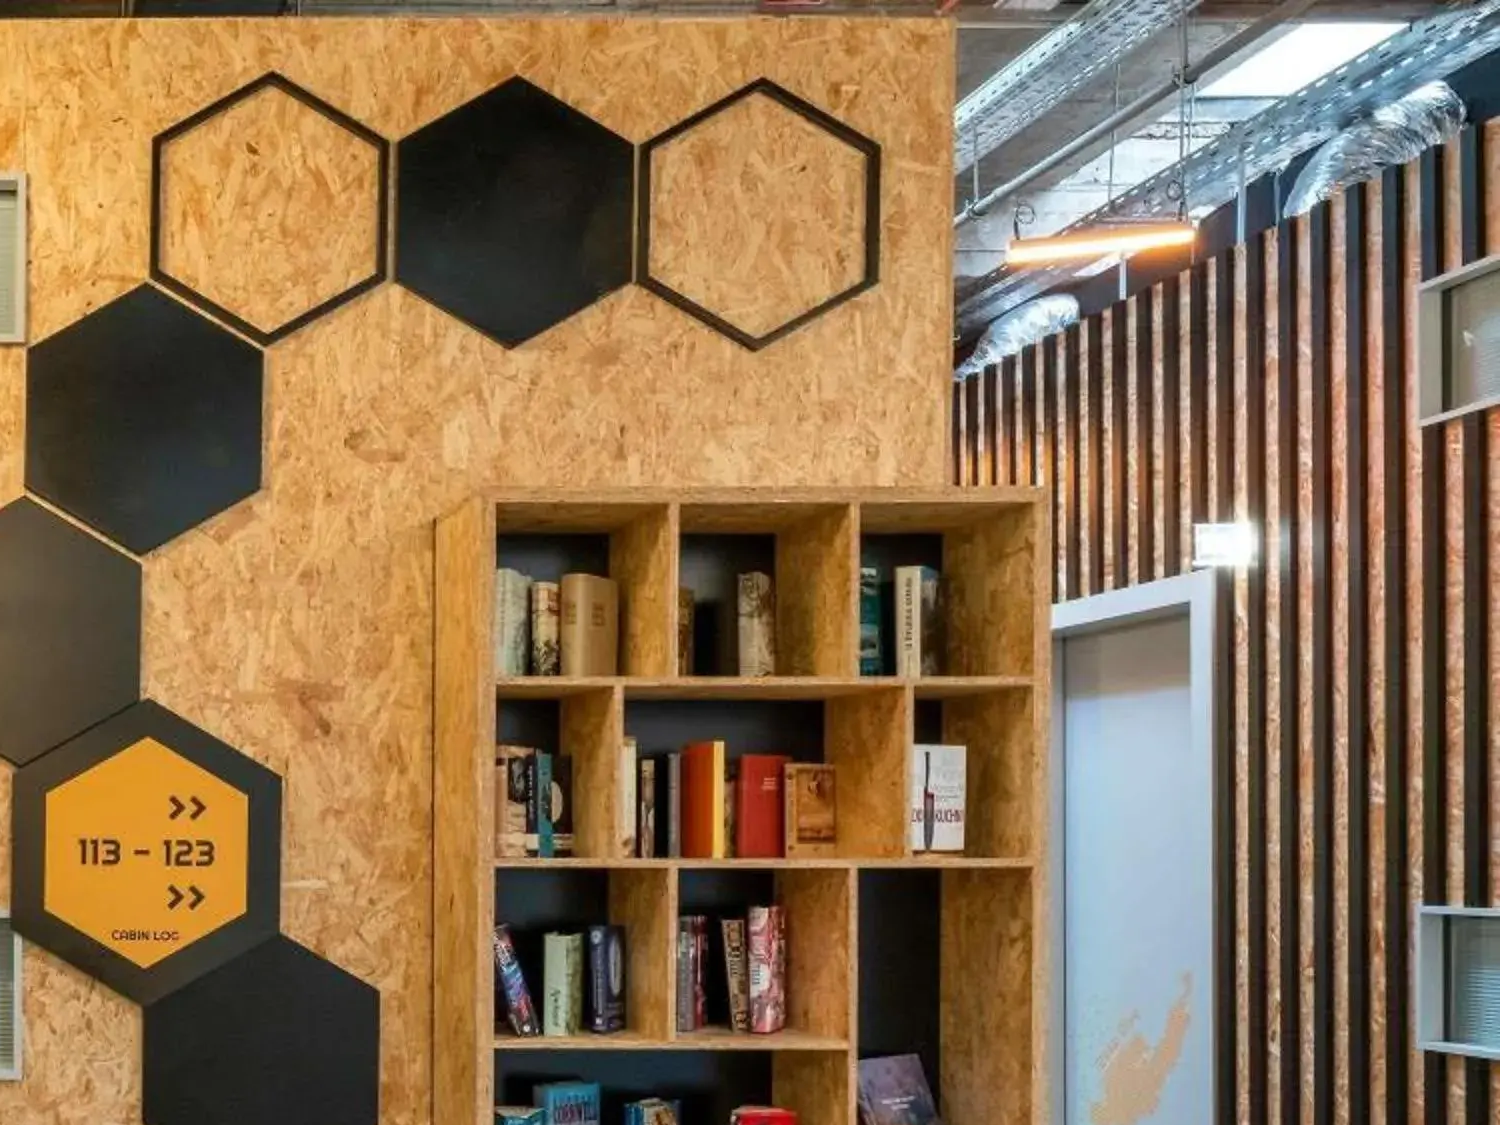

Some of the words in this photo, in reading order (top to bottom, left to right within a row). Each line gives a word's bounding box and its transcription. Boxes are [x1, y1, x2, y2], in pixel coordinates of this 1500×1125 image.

[78, 838, 121, 866] 113
[163, 838, 216, 867] 123
[111, 929, 150, 941] CABIN
[153, 930, 180, 942] LOG
